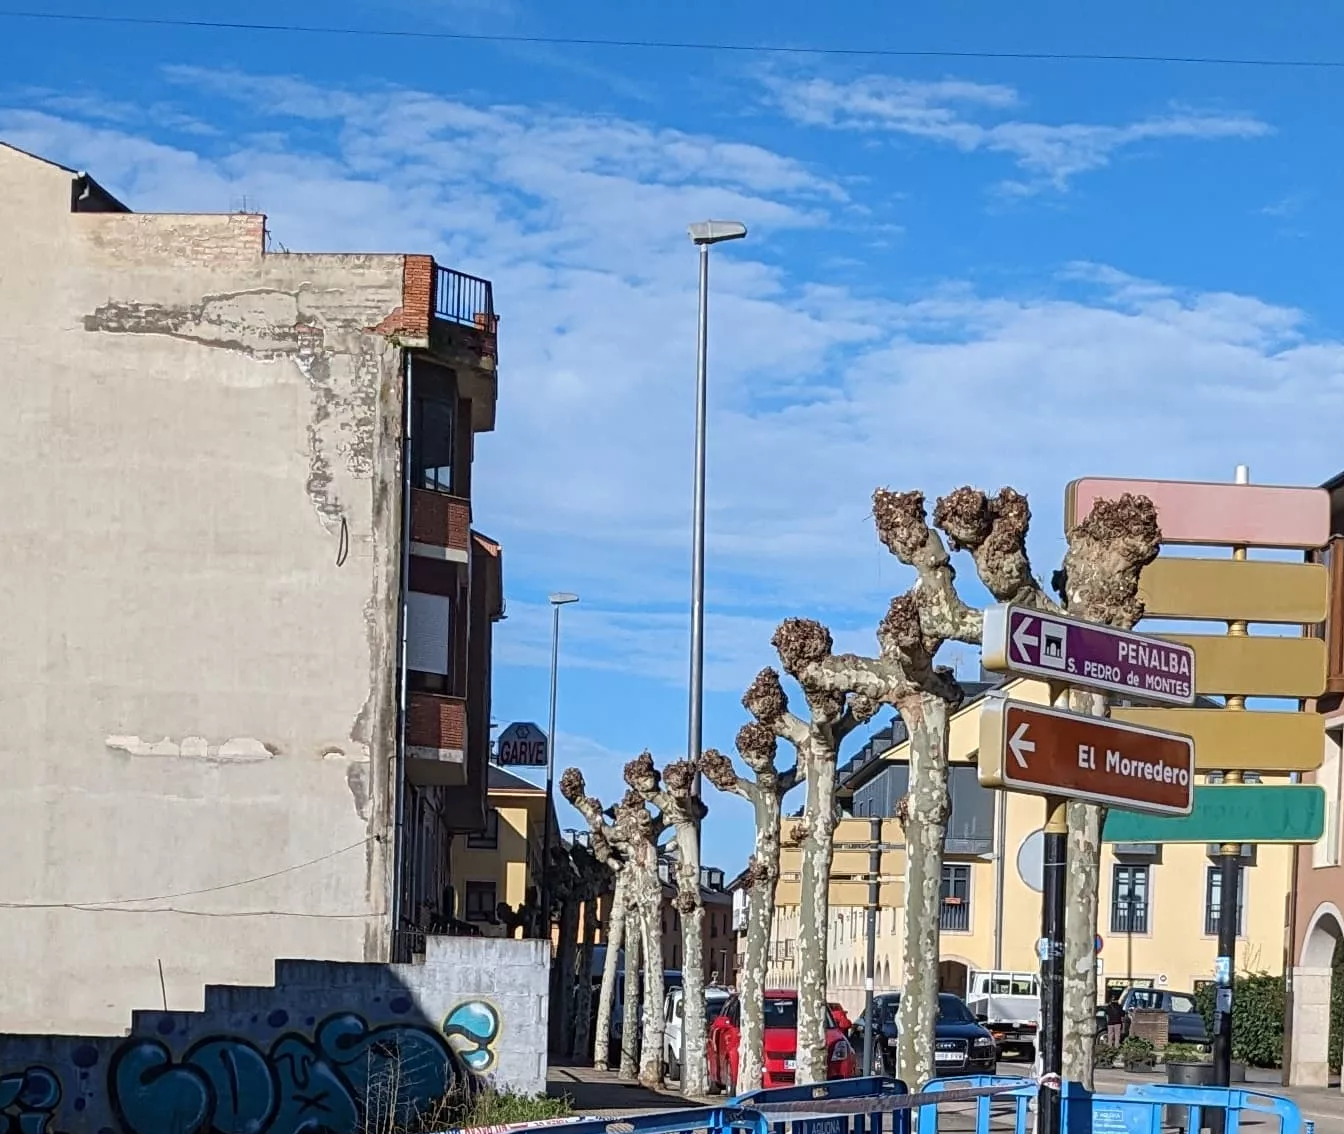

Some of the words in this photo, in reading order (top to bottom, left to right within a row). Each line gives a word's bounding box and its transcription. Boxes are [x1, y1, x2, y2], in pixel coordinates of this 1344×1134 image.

[1067, 657, 1078, 674] S.
[1084, 661, 1121, 682] PEDRO
[1127, 673, 1140, 687] de
[1145, 674, 1190, 697] MONTES
[1118, 641, 1190, 677] PEÑALBA
[500, 741, 545, 764] GARVE
[1078, 744, 1095, 770] El
[1106, 750, 1189, 787] Morredero
